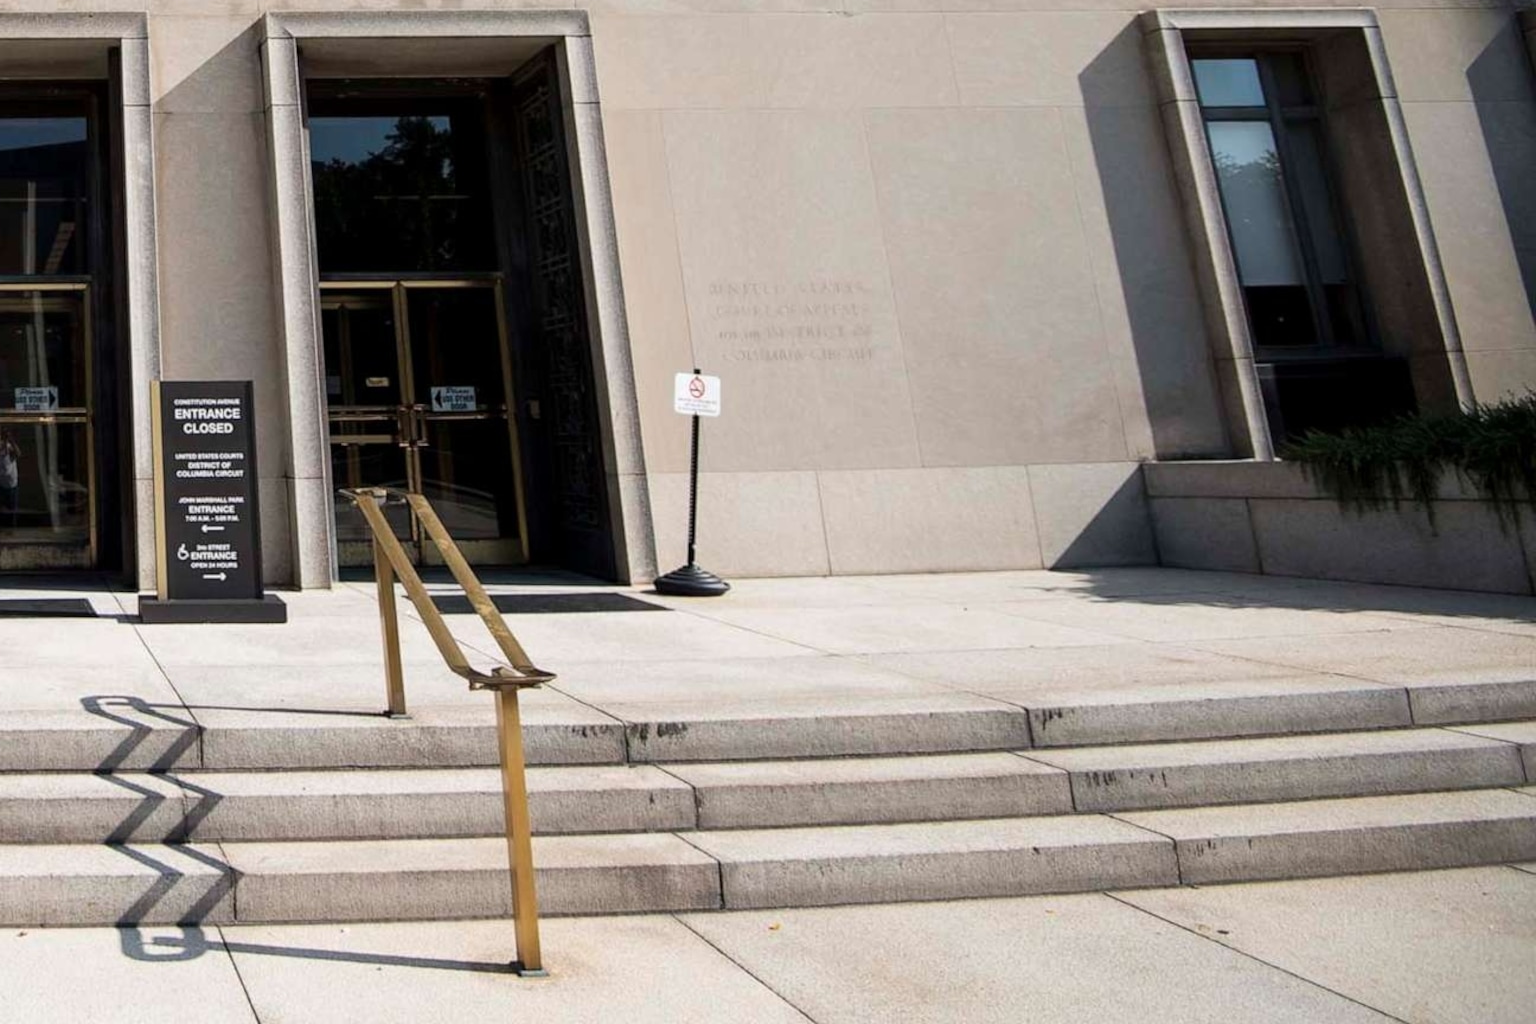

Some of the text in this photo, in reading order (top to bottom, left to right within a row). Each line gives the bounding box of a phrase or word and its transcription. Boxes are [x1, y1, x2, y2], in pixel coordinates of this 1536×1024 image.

[174, 408, 241, 419] ENTRANCE
[183, 423, 233, 434] CLOSED
[176, 470, 214, 478] COLUMBIA
[188, 505, 235, 514] ENTRANCE
[190, 551, 237, 560] ENTRANCE
